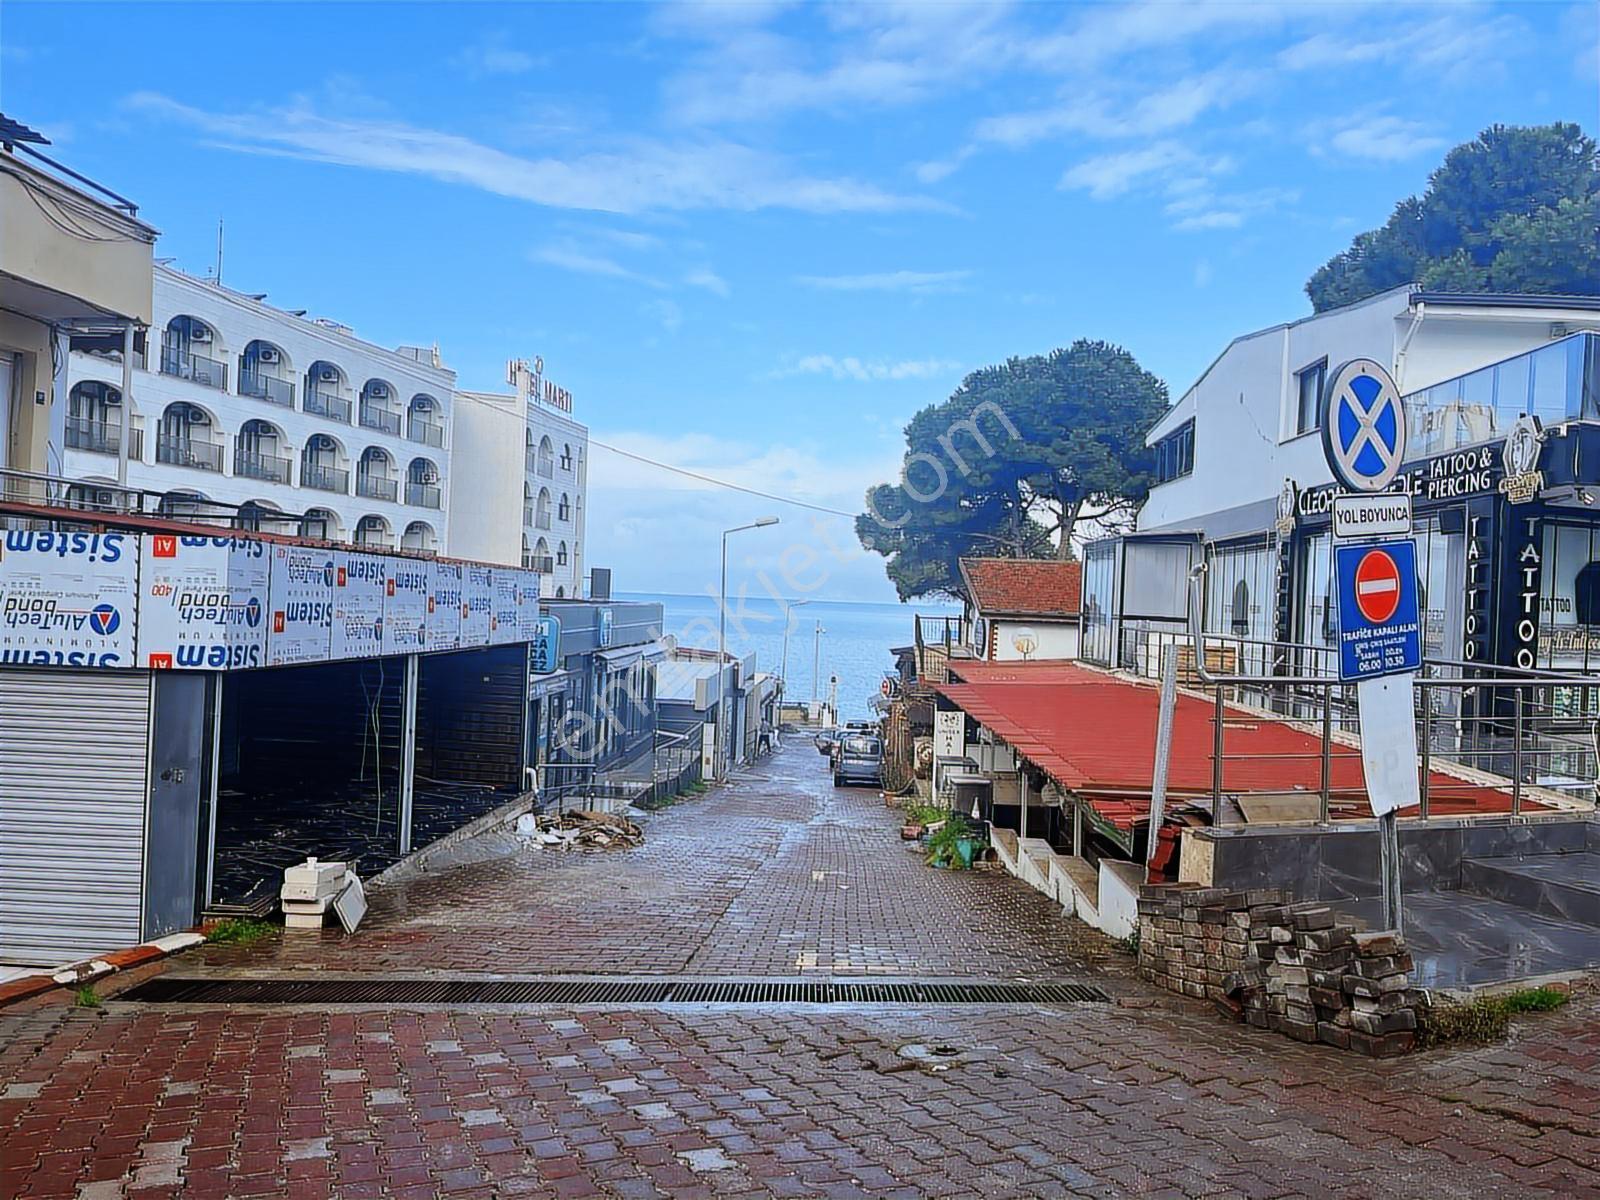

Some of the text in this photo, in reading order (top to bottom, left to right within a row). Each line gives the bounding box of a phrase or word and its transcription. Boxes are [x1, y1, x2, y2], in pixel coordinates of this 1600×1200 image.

[1430, 447, 1492, 479] TATTOO &
[1428, 470, 1491, 500] PIERCING
[6, 530, 125, 563] Sistem
[347, 560, 385, 586] Sistem
[395, 572, 427, 595] Sistem
[152, 585, 173, 597] 400
[435, 590, 462, 610] Sistem
[1466, 517, 1480, 660] TATTOO
[1517, 517, 1540, 670] TATTOO
[3, 598, 57, 617] bond
[179, 594, 230, 612] bond
[286, 602, 333, 627] Sistem
[6, 612, 87, 631] AluTech
[181, 608, 245, 624] AluTech
[1398, 623, 1417, 633] ALAN
[177, 644, 260, 669] Sistem
